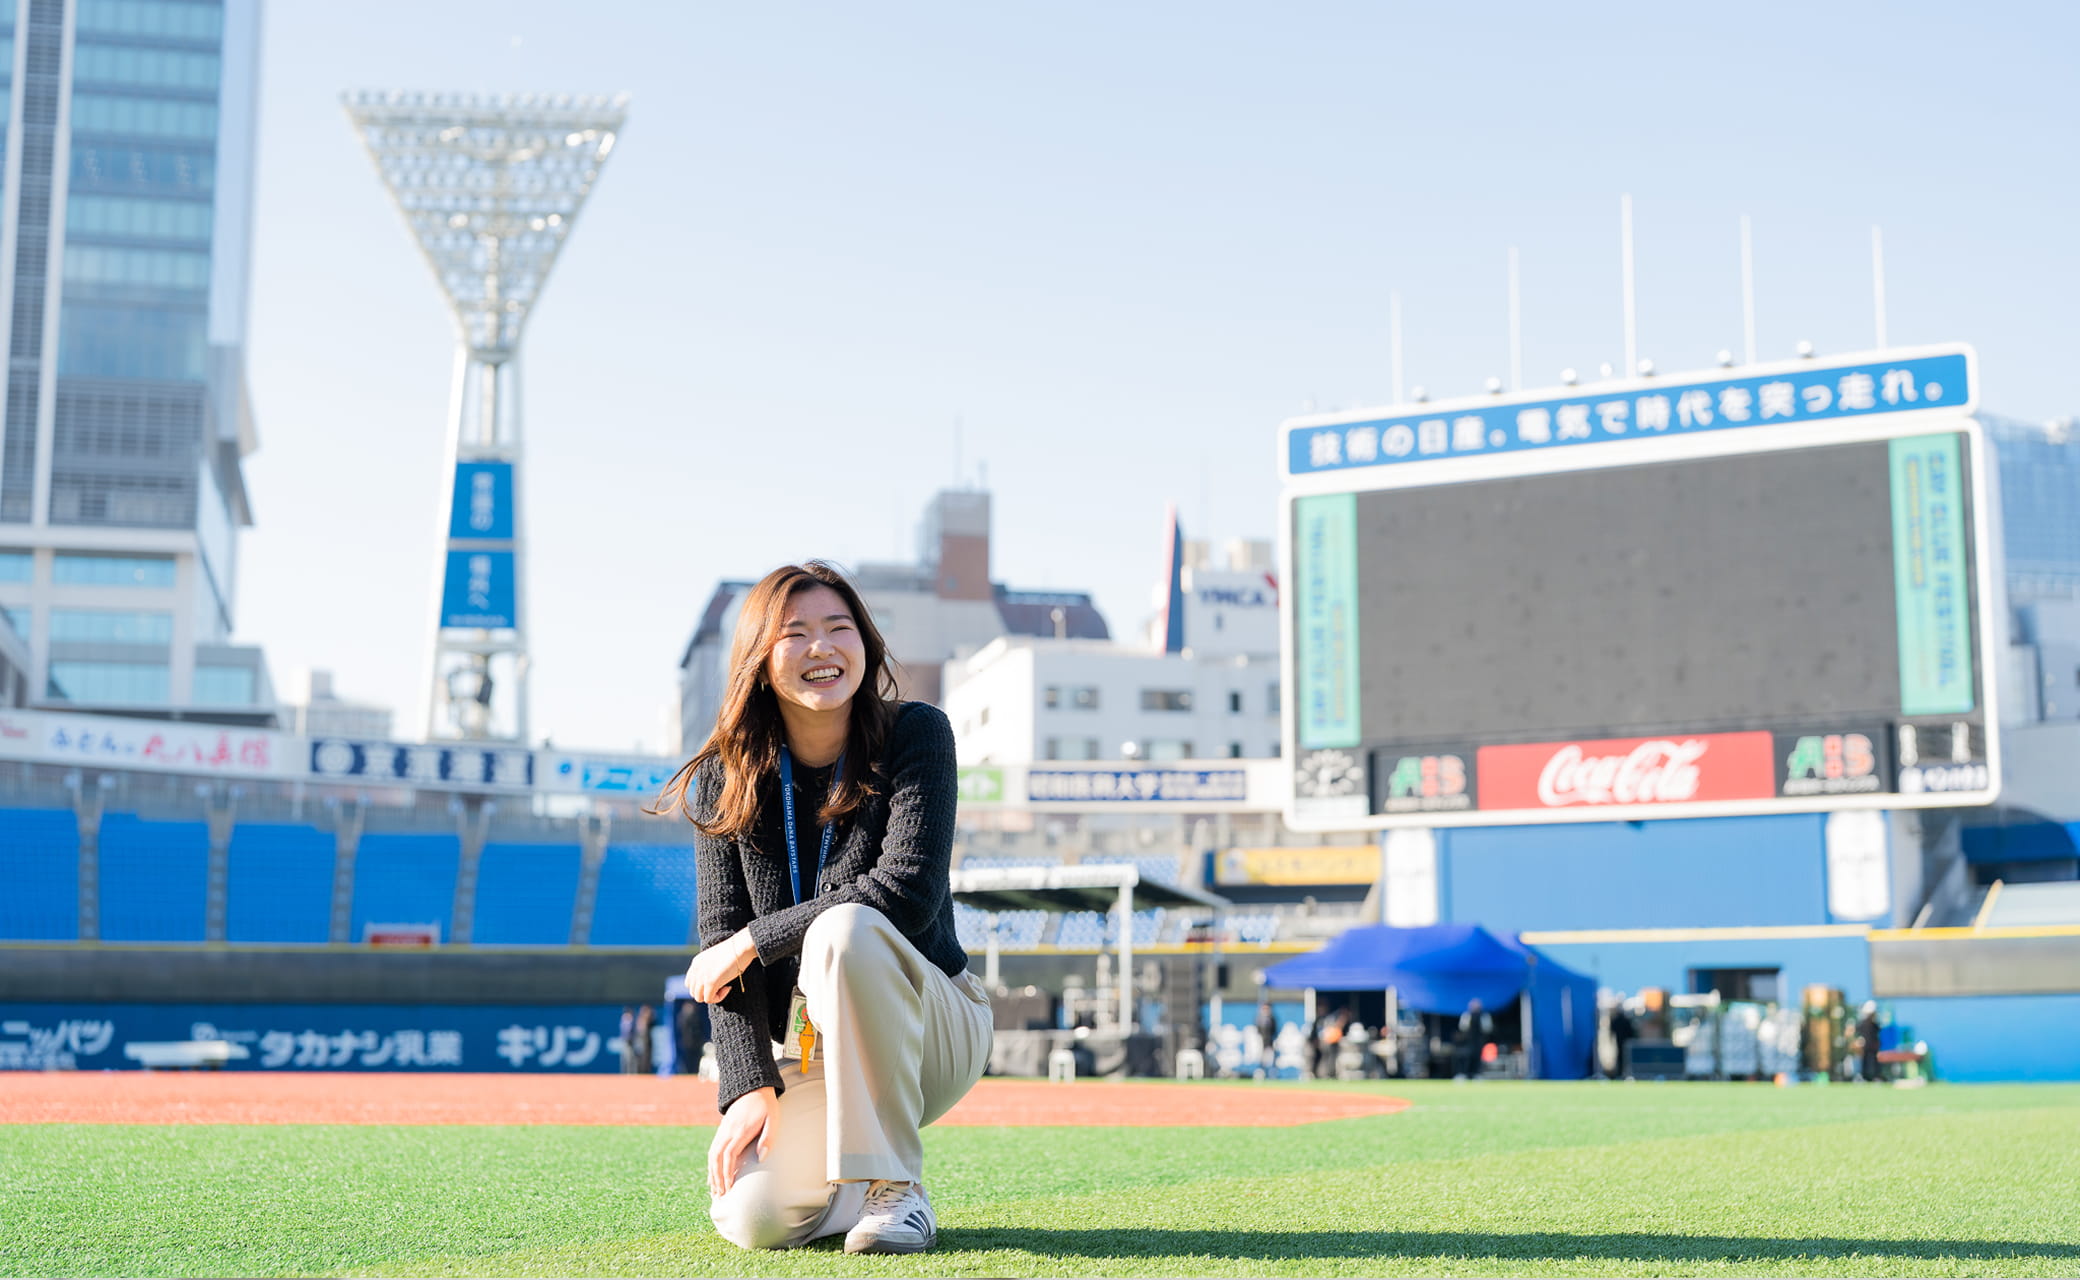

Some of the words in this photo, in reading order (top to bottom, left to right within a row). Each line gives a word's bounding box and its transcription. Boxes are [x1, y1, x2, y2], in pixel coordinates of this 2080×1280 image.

[1309, 367, 1945, 467] 技術の日産。電気で時代を突っ走れ。
[1199, 586, 1266, 607] YMCA
[784, 783, 793, 820] YOKOHAMA
[787, 821, 795, 840] DeNA
[789, 840, 798, 874] BAYSTARS
[1, 1019, 114, 1056] ニッパツ
[260, 1029, 463, 1068] タカナシ乳業
